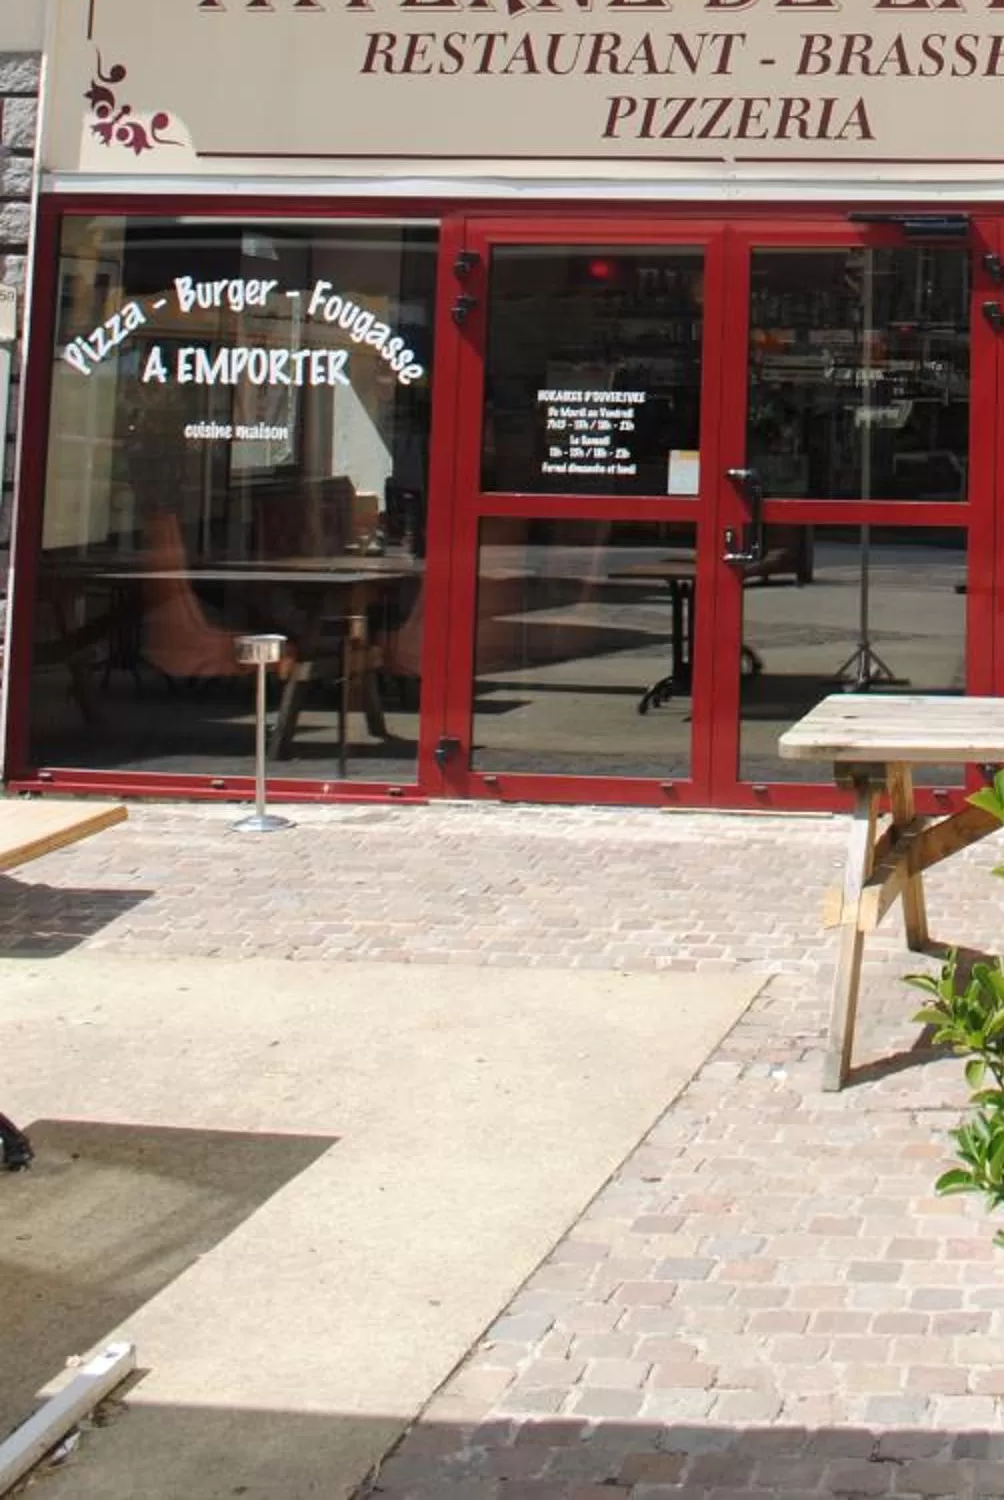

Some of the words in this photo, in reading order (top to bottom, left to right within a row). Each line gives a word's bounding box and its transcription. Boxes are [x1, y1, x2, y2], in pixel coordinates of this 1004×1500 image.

[360, 32, 746, 75] RESTAURANT
[602, 97, 876, 140] PIZZERIA
[63, 299, 147, 377] Pizza
[174, 275, 279, 313] Burger
[307, 279, 425, 386] Fougasse
[142, 345, 168, 384] A
[177, 346, 351, 387] EMPORTER
[184, 420, 232, 439] cuisine
[235, 421, 288, 439] maison
